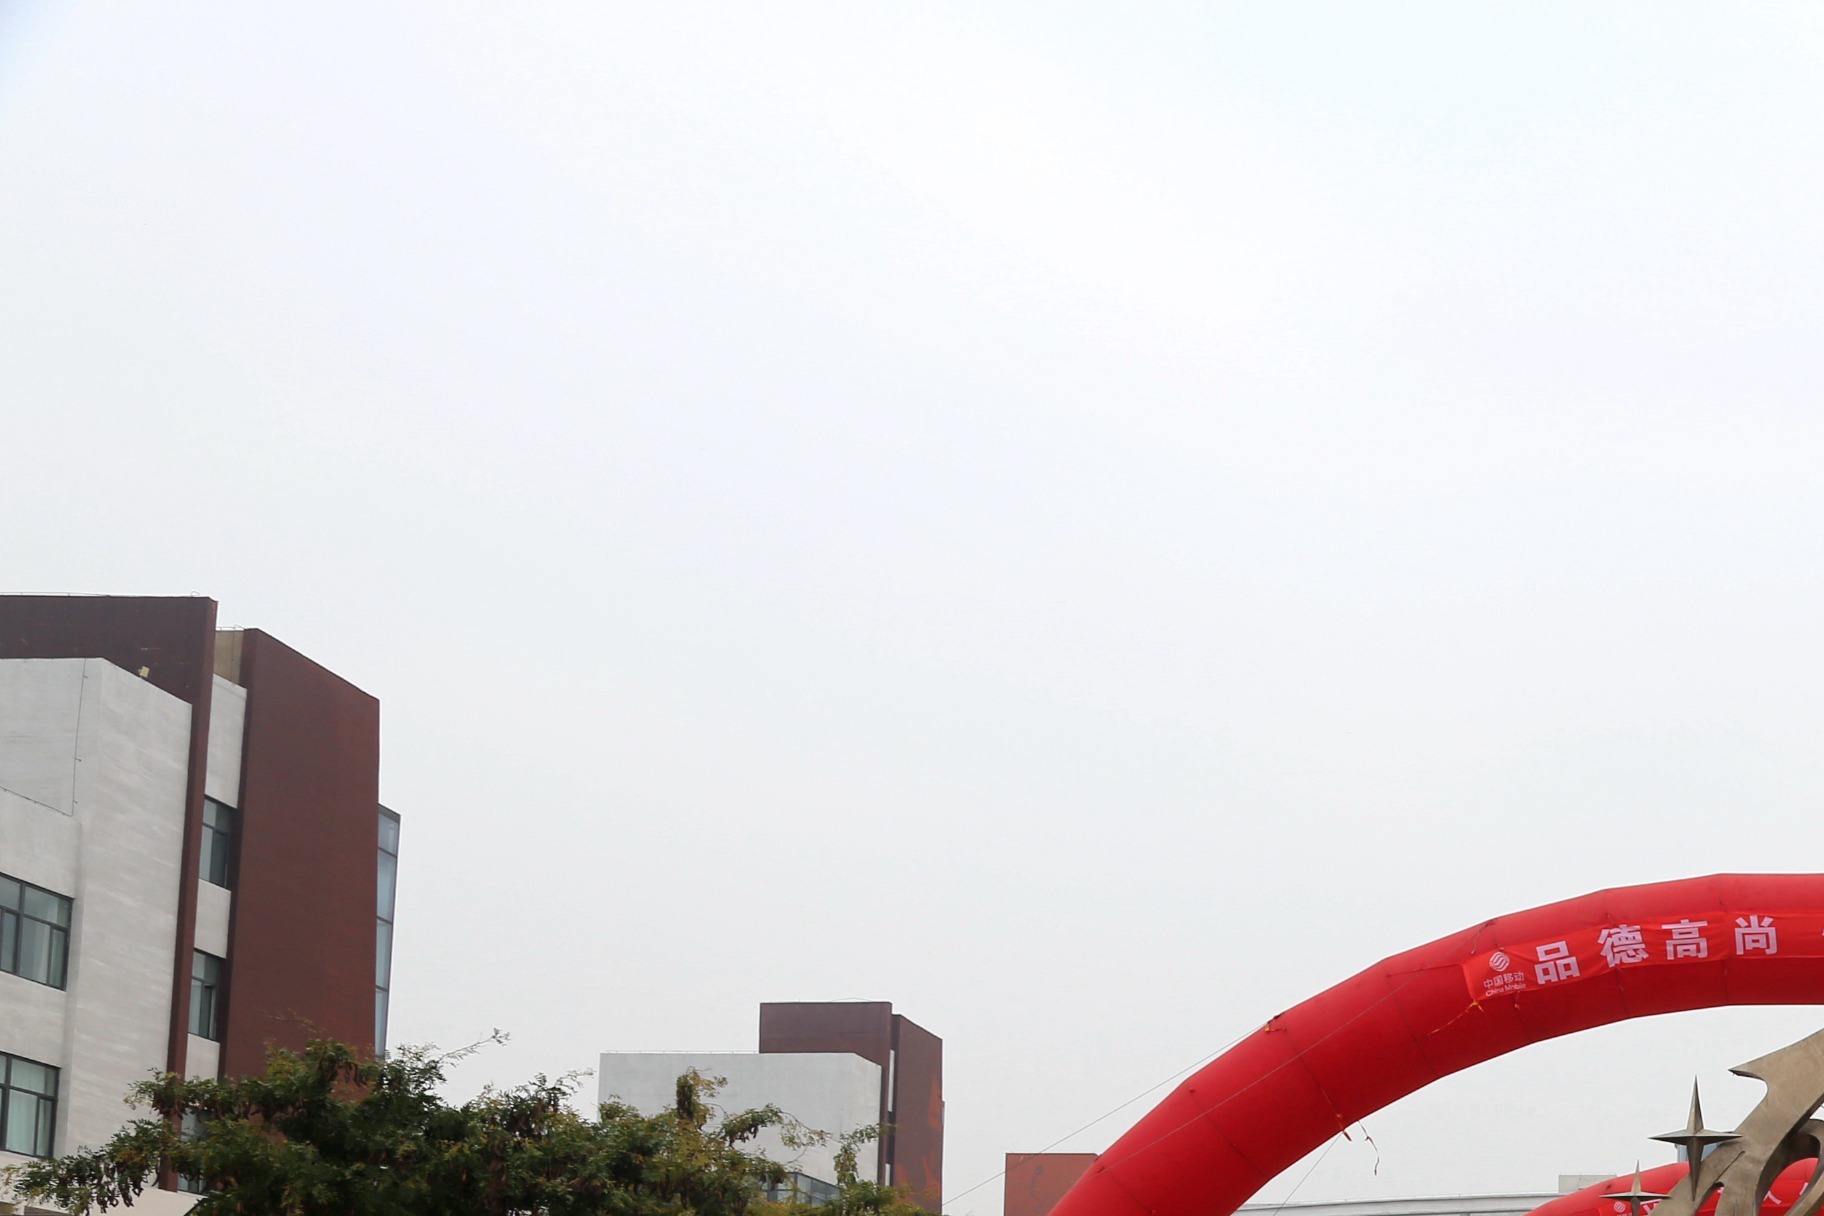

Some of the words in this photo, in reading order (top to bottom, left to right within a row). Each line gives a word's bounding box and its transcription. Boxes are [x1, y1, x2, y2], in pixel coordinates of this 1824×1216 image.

[1534, 914, 1778, 985] 品德高尚
[1484, 971, 1525, 989] 中国移动
[1485, 983, 1504, 997] China
